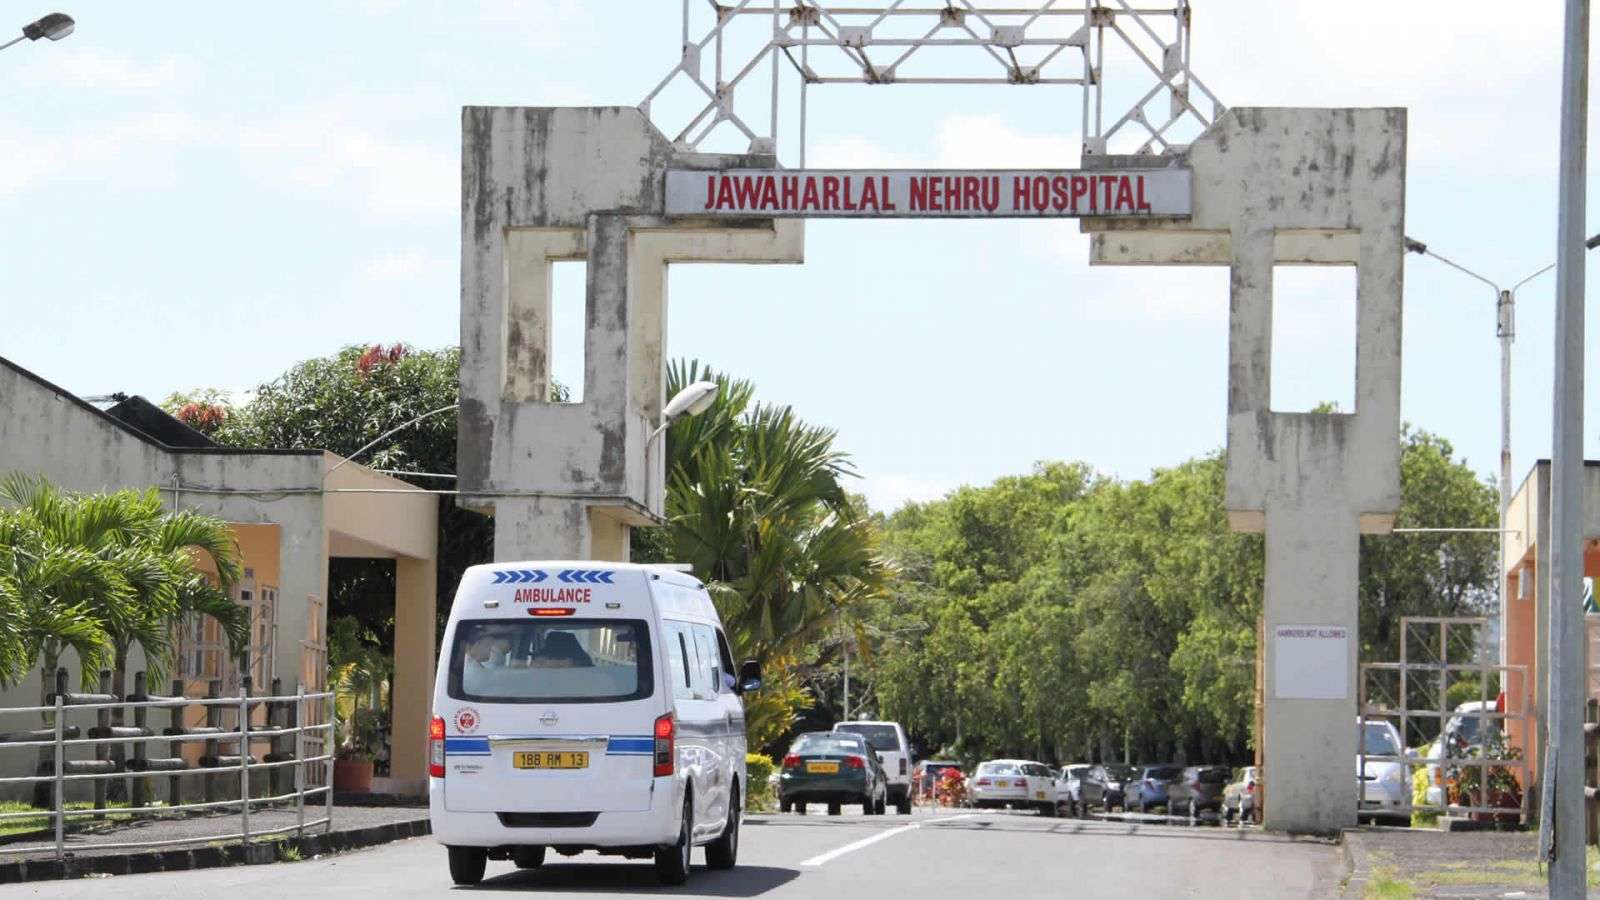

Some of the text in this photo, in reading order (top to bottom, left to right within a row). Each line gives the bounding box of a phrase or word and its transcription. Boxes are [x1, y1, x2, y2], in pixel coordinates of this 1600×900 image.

[705, 175, 1152, 211] JAWAHARLAL NEHRU HOSPITAL
[514, 588, 592, 603] AMBULANCE
[521, 753, 541, 766] 188
[570, 753, 584, 766] 13
